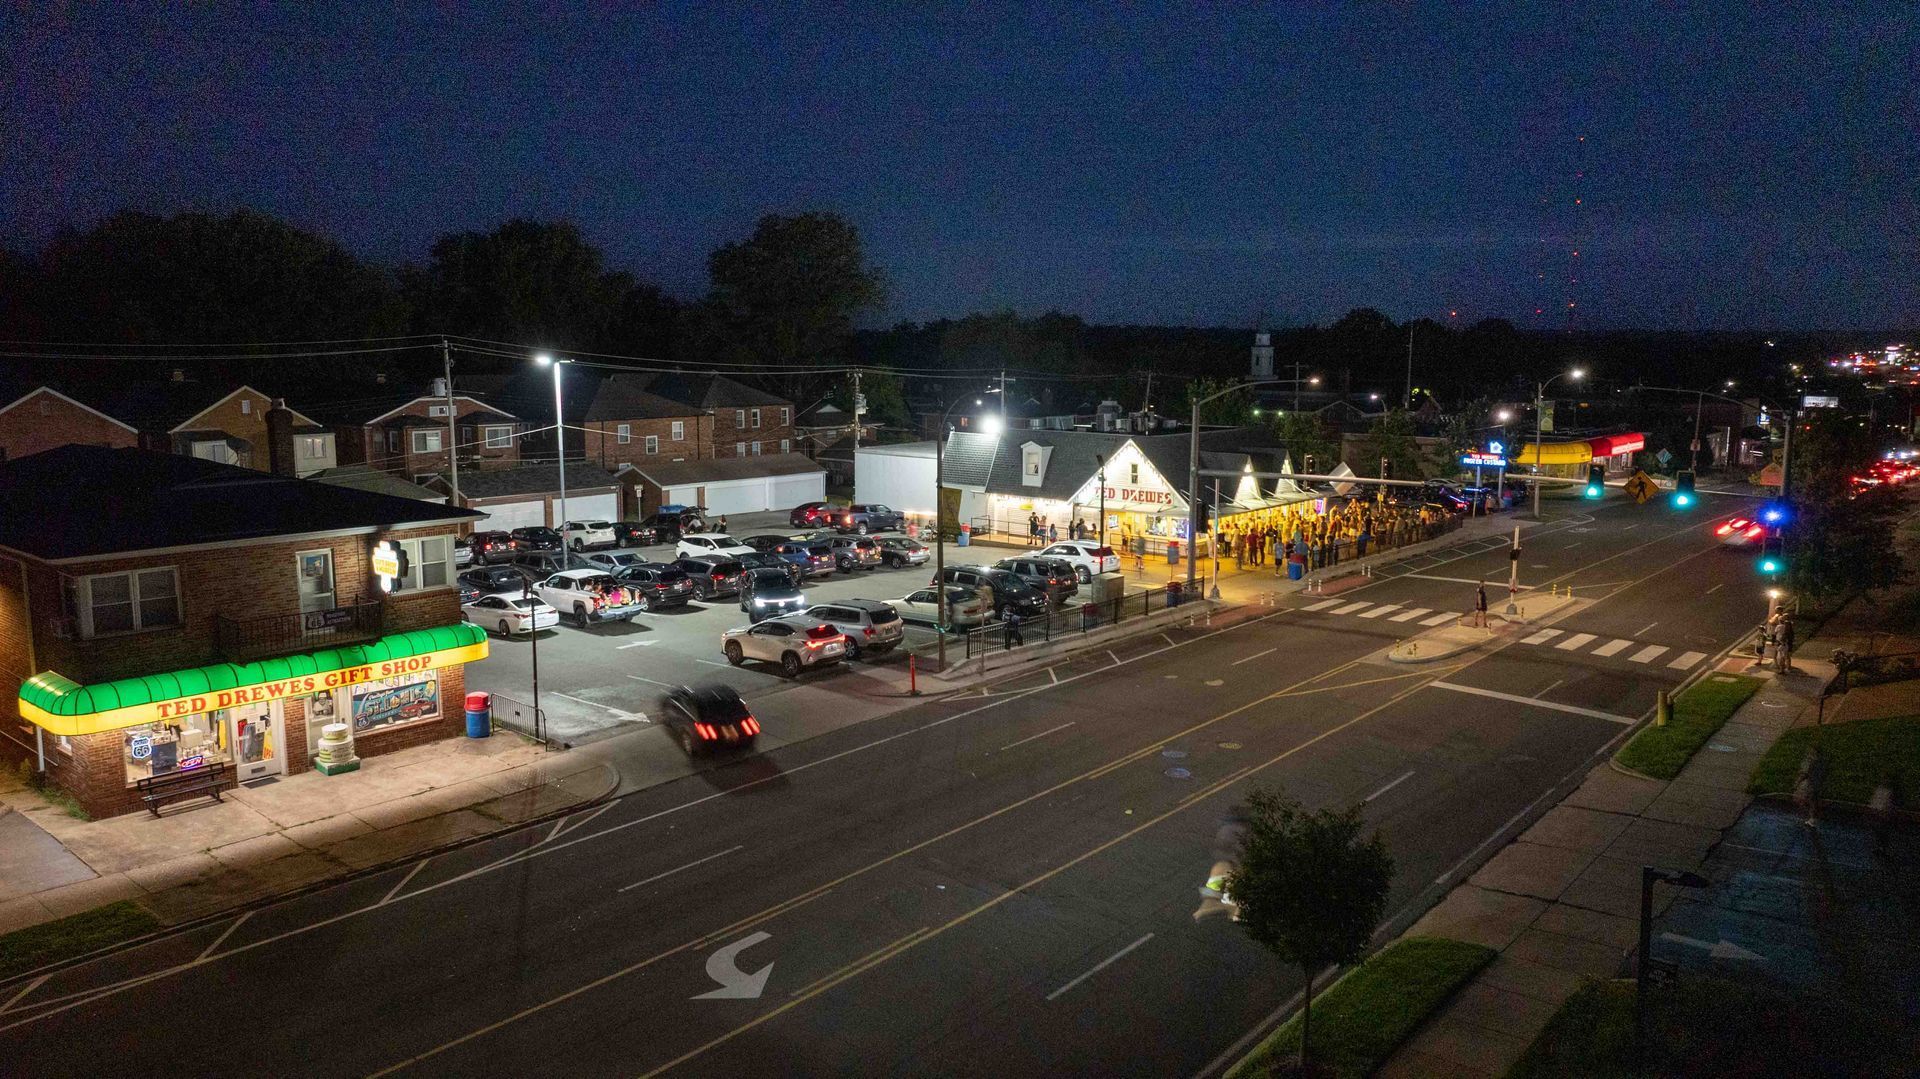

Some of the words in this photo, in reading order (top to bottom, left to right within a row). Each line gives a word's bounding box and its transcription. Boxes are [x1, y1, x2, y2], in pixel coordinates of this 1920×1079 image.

[1094, 487, 1116, 499] TED
[1122, 488, 1172, 504] DREWES
[157, 697, 207, 718] TED
[217, 679, 315, 707] DREWES
[324, 667, 373, 687] GIFT
[381, 655, 433, 676] SHOP
[134, 745, 149, 757] 66
[181, 756, 202, 768] OPEN
